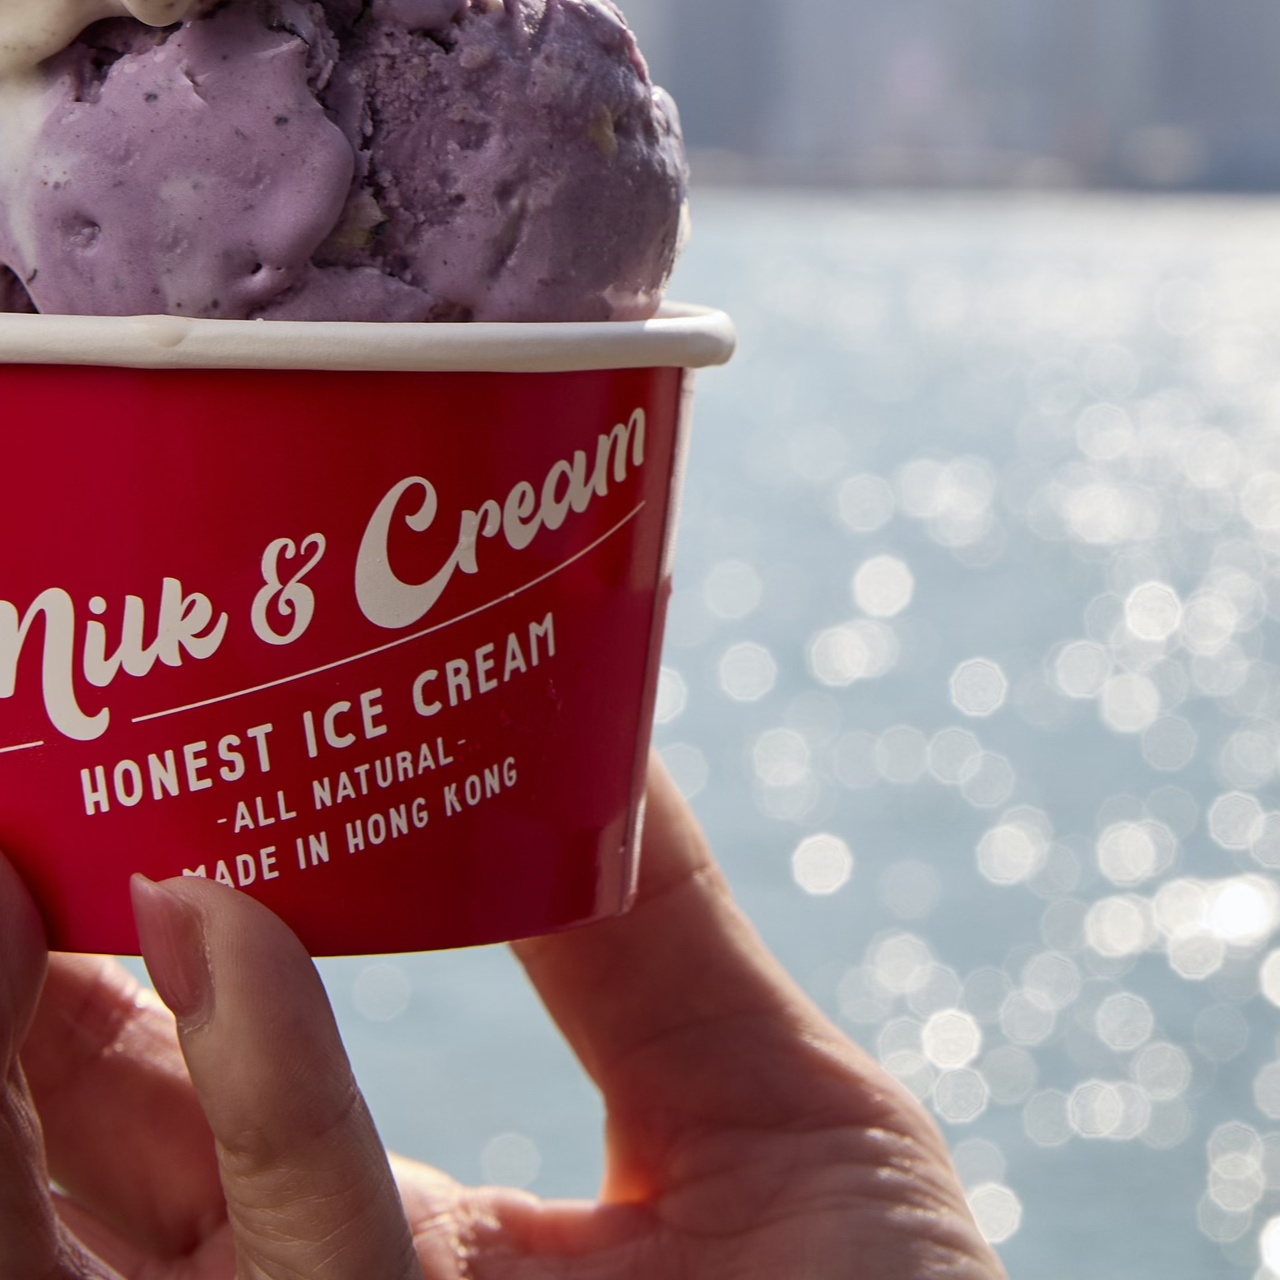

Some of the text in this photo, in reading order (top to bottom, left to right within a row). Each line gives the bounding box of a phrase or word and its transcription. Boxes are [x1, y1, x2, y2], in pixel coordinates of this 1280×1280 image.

[251, 533, 326, 647] &
[354, 407, 646, 629] Cream
[80, 612, 556, 816] HONEST ICE CREAM
[182, 756, 517, 889] ADE IN HONG KONG
